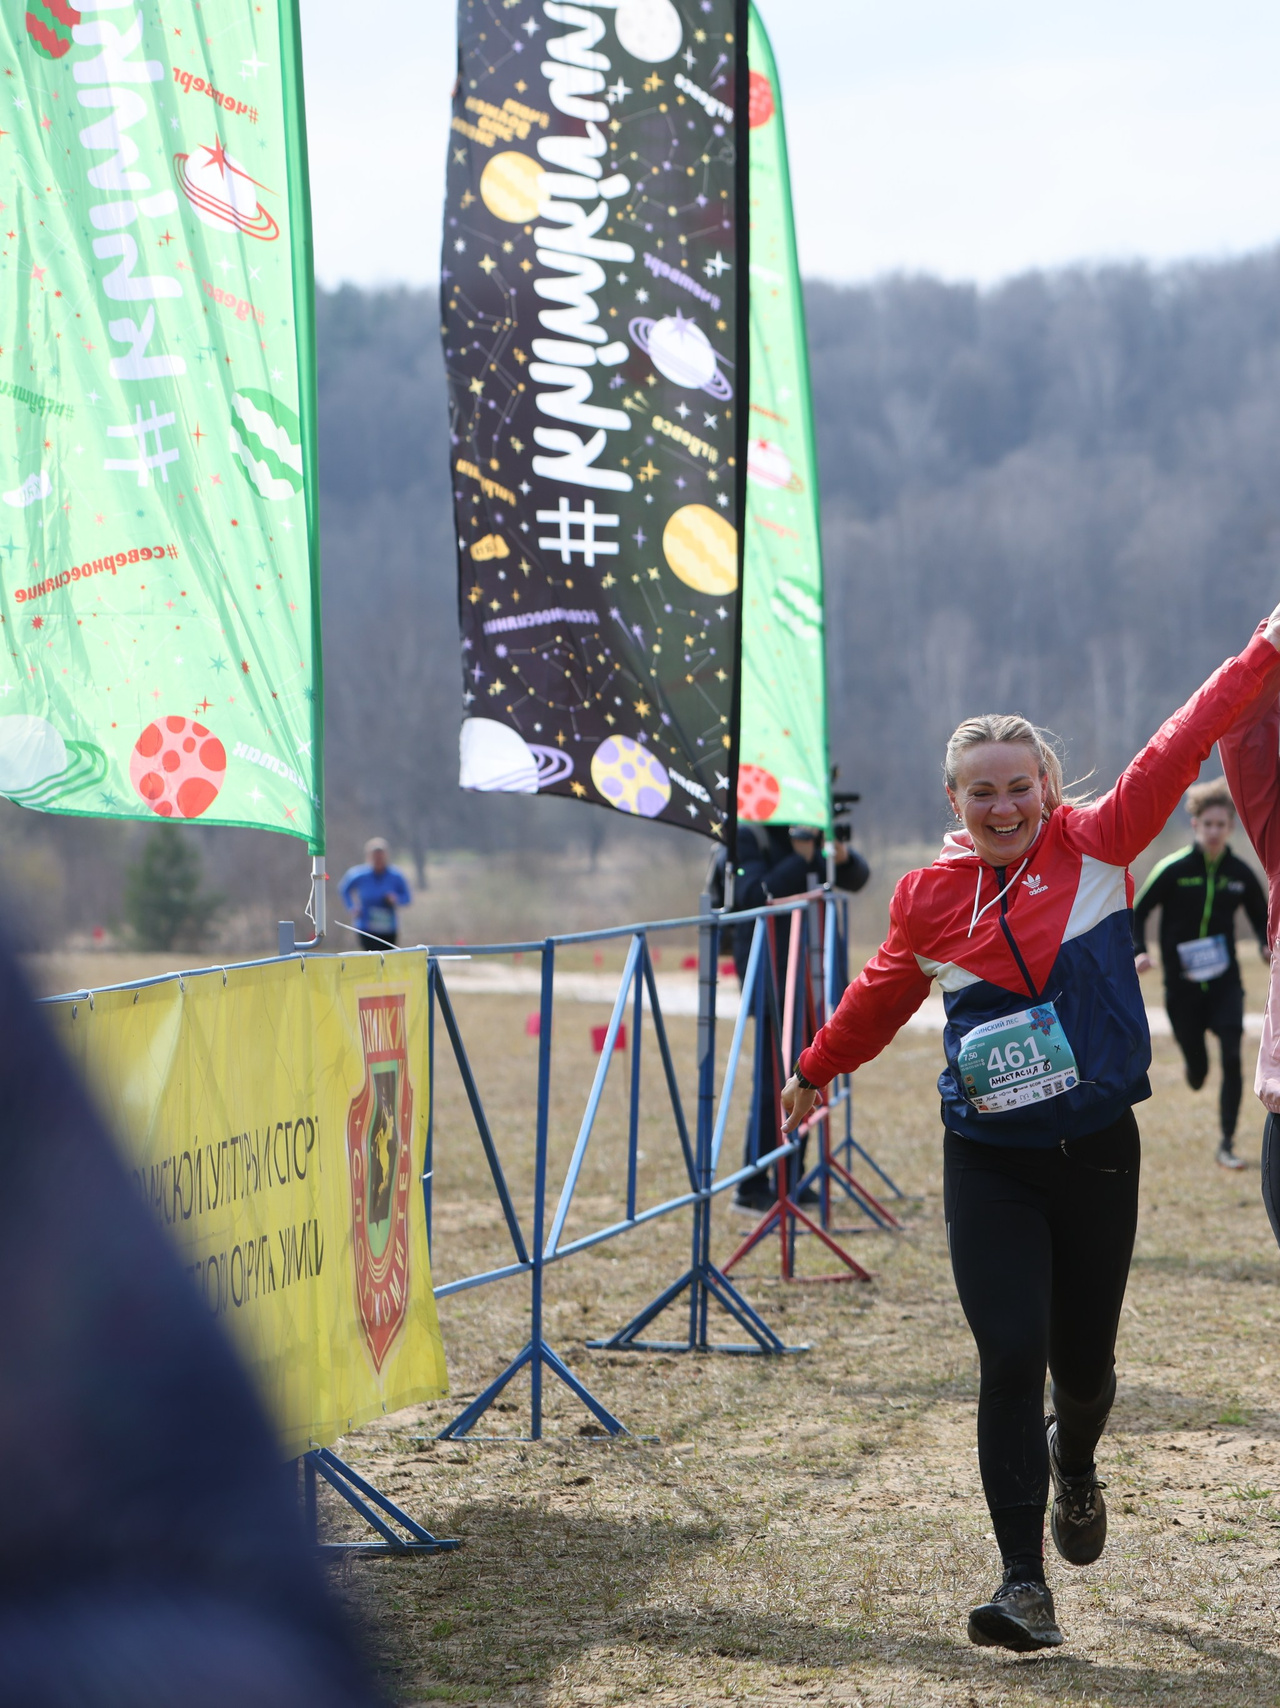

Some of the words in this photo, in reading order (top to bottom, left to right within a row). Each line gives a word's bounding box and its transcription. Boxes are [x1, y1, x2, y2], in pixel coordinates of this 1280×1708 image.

[1029, 885, 1049, 896] adidas
[961, 1020, 1006, 1043] КИНСКИЙ
[1005, 1017, 1019, 1027] ЛЕС
[986, 1035, 1047, 1073] 461
[990, 1065, 1039, 1087] АНАСТАСИЯ
